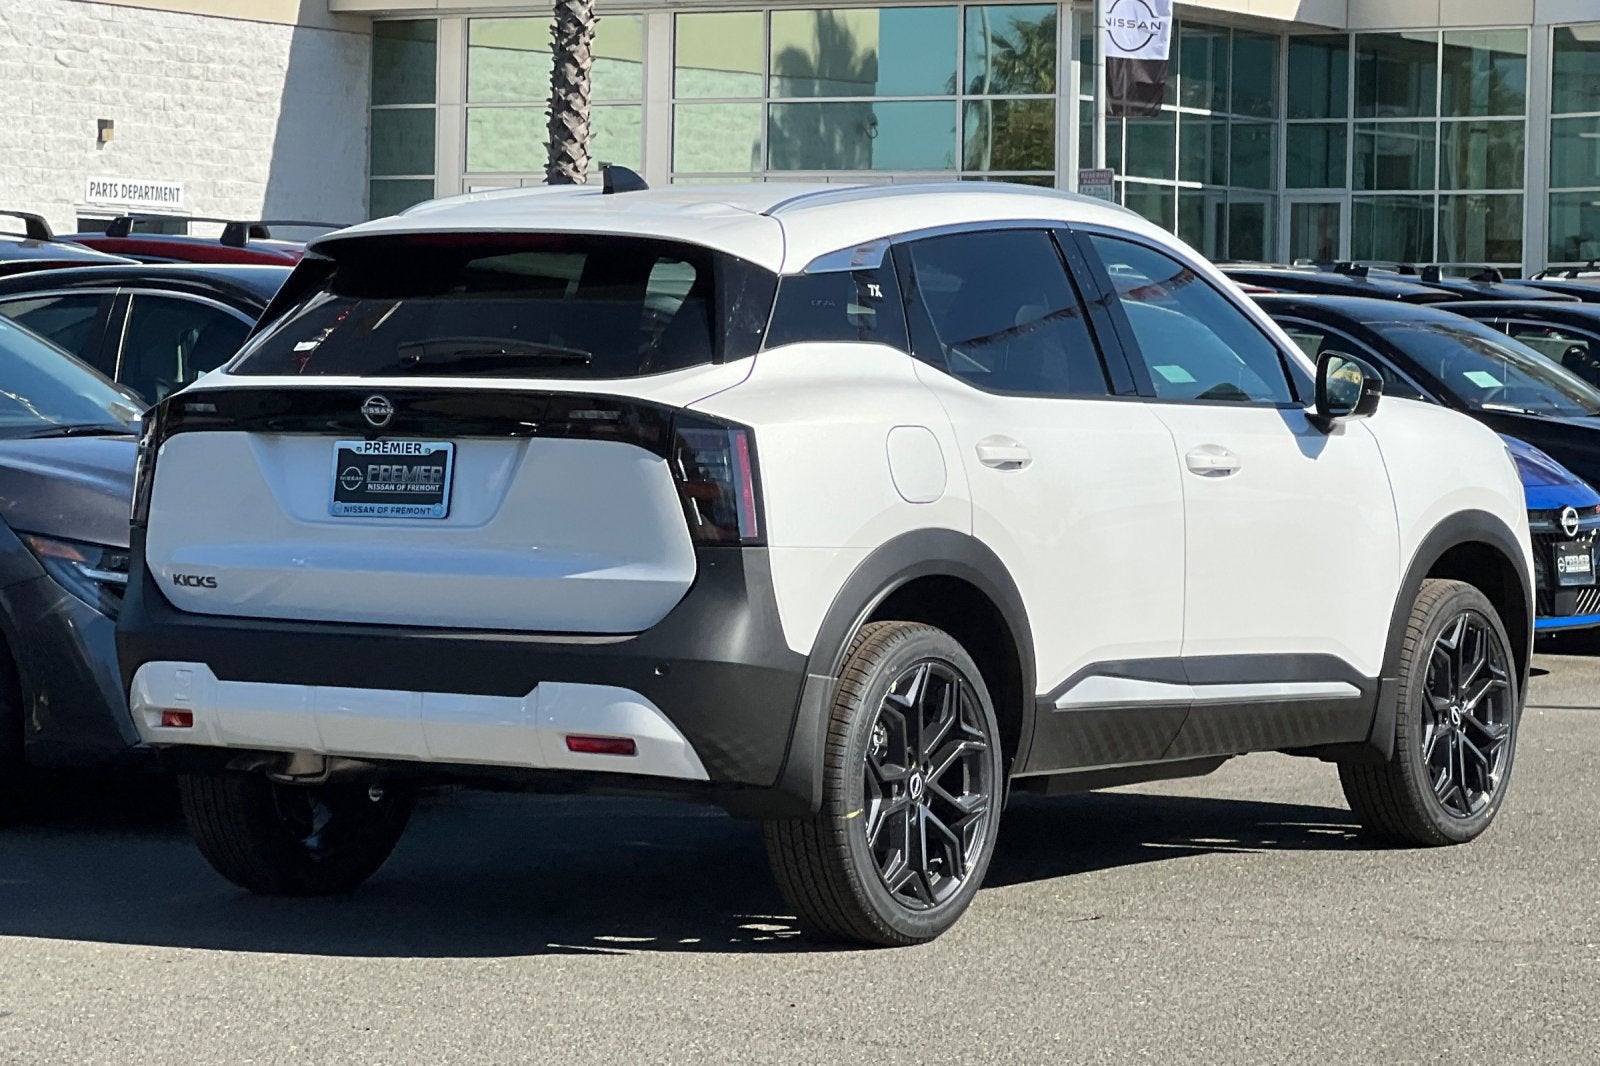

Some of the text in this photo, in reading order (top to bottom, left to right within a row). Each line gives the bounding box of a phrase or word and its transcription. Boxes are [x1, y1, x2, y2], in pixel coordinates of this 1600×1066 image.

[1105, 17, 1161, 30] NISSAN
[89, 181, 180, 202] PARTS DEPARTMENT
[364, 442, 422, 454] PREMIER
[367, 464, 443, 484] PREMIER
[367, 483, 395, 491] NISSAN
[407, 484, 440, 492] FREMONT
[343, 506, 432, 515] NISSAN OF FREMONT
[173, 573, 217, 588] KICKS
